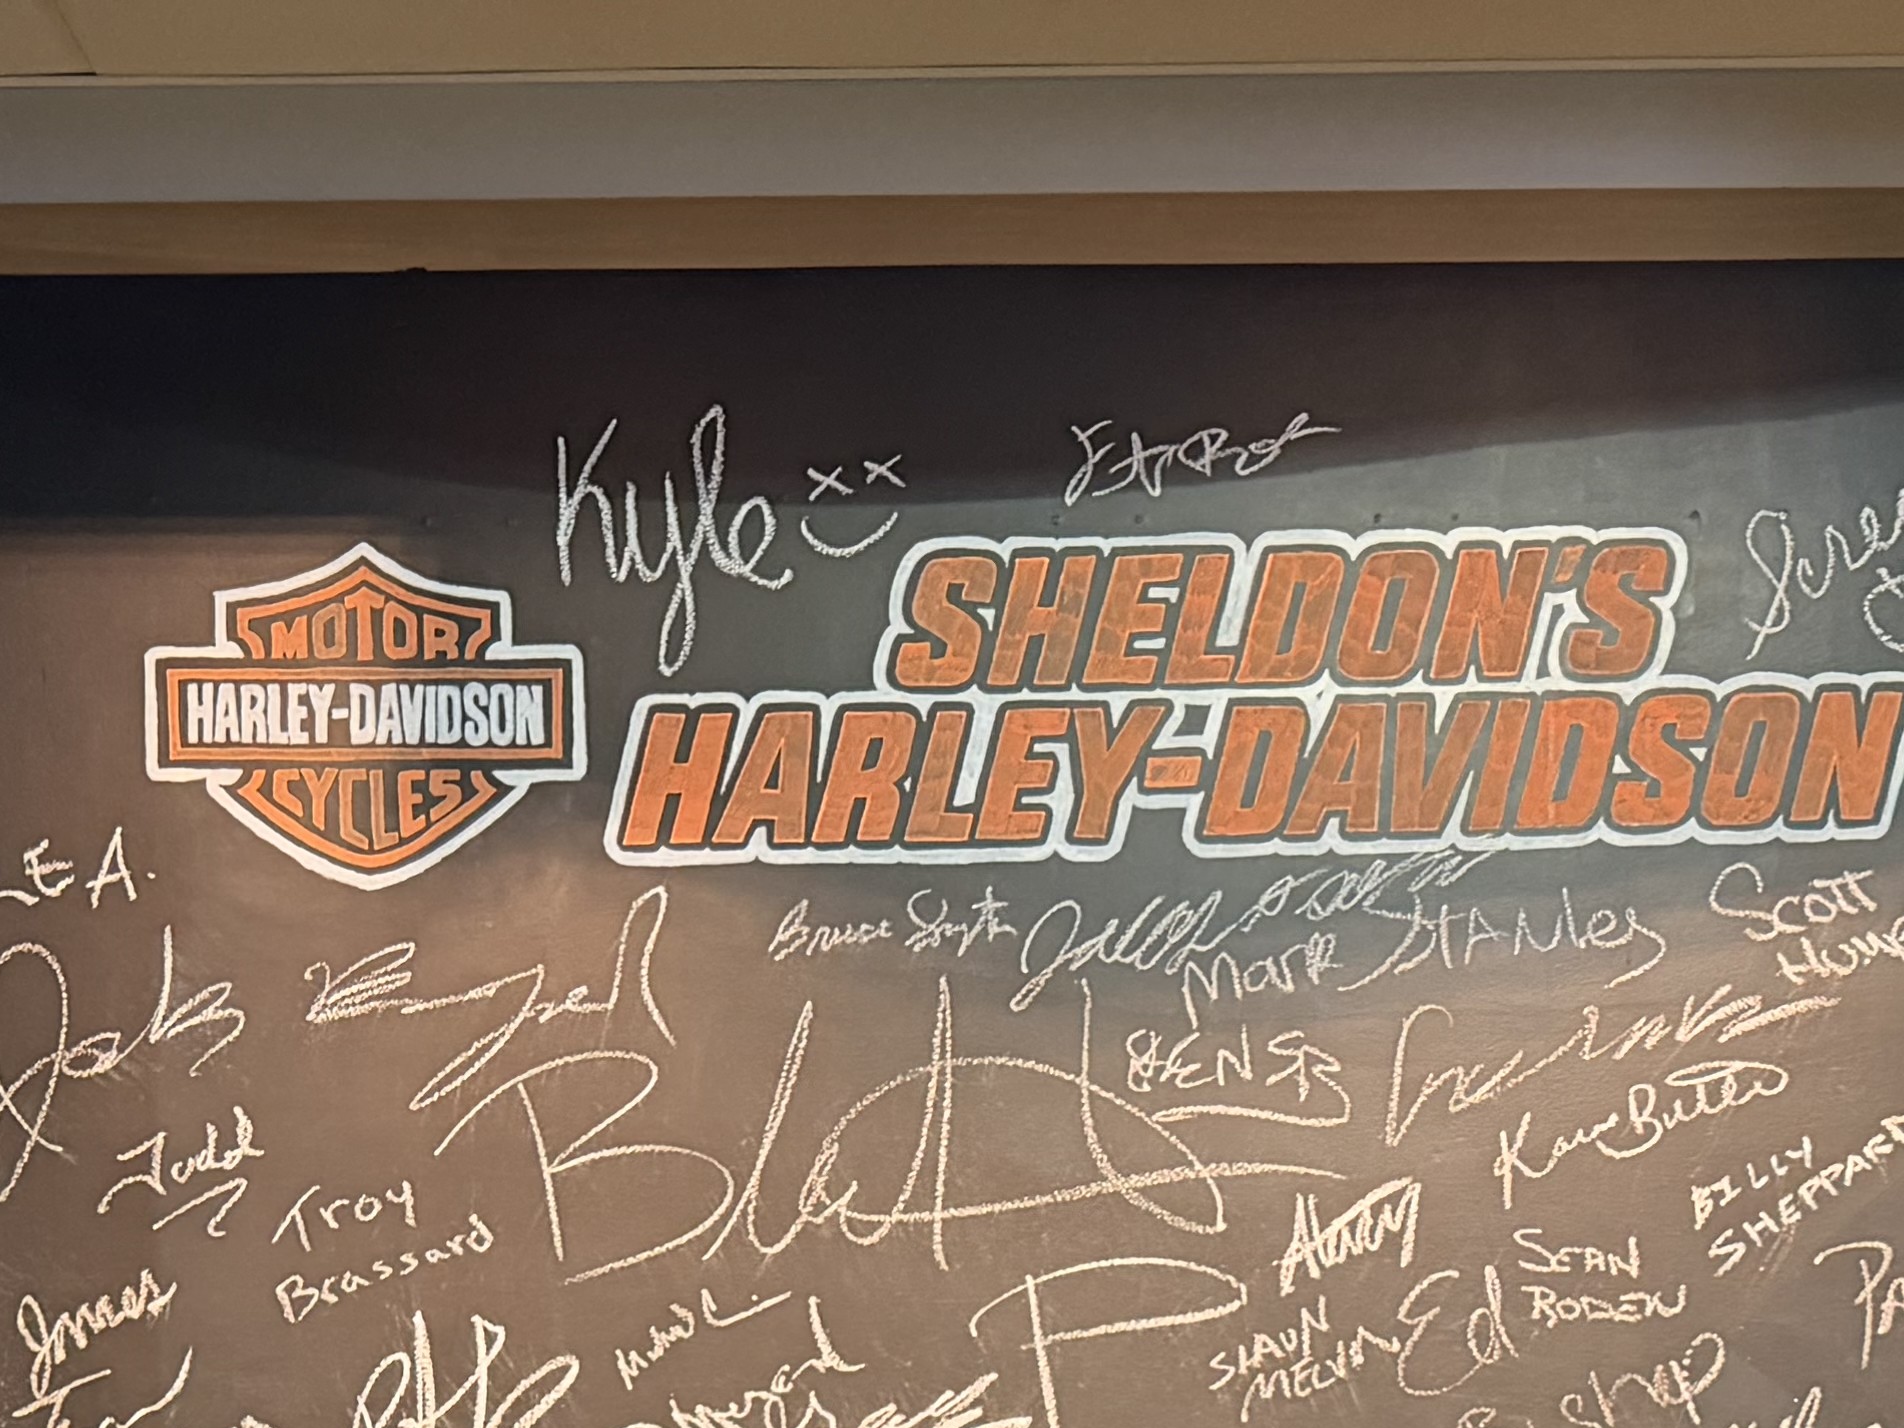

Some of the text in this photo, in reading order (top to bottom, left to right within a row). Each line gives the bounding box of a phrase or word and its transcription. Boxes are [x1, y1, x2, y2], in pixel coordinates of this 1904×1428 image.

[556, 402, 794, 678] Kyle
[270, 587, 461, 661] MOTOR
[894, 543, 1669, 689] SHELDON'S
[187, 681, 546, 748] HARLEY-DAVIDSON
[271, 767, 464, 851] CYCLES
[271, 1180, 417, 1252] Troy
[1691, 1135, 1814, 1231] BILLY
[274, 1213, 494, 1325] Brassard
[1512, 1226, 1642, 1279] SEAN
